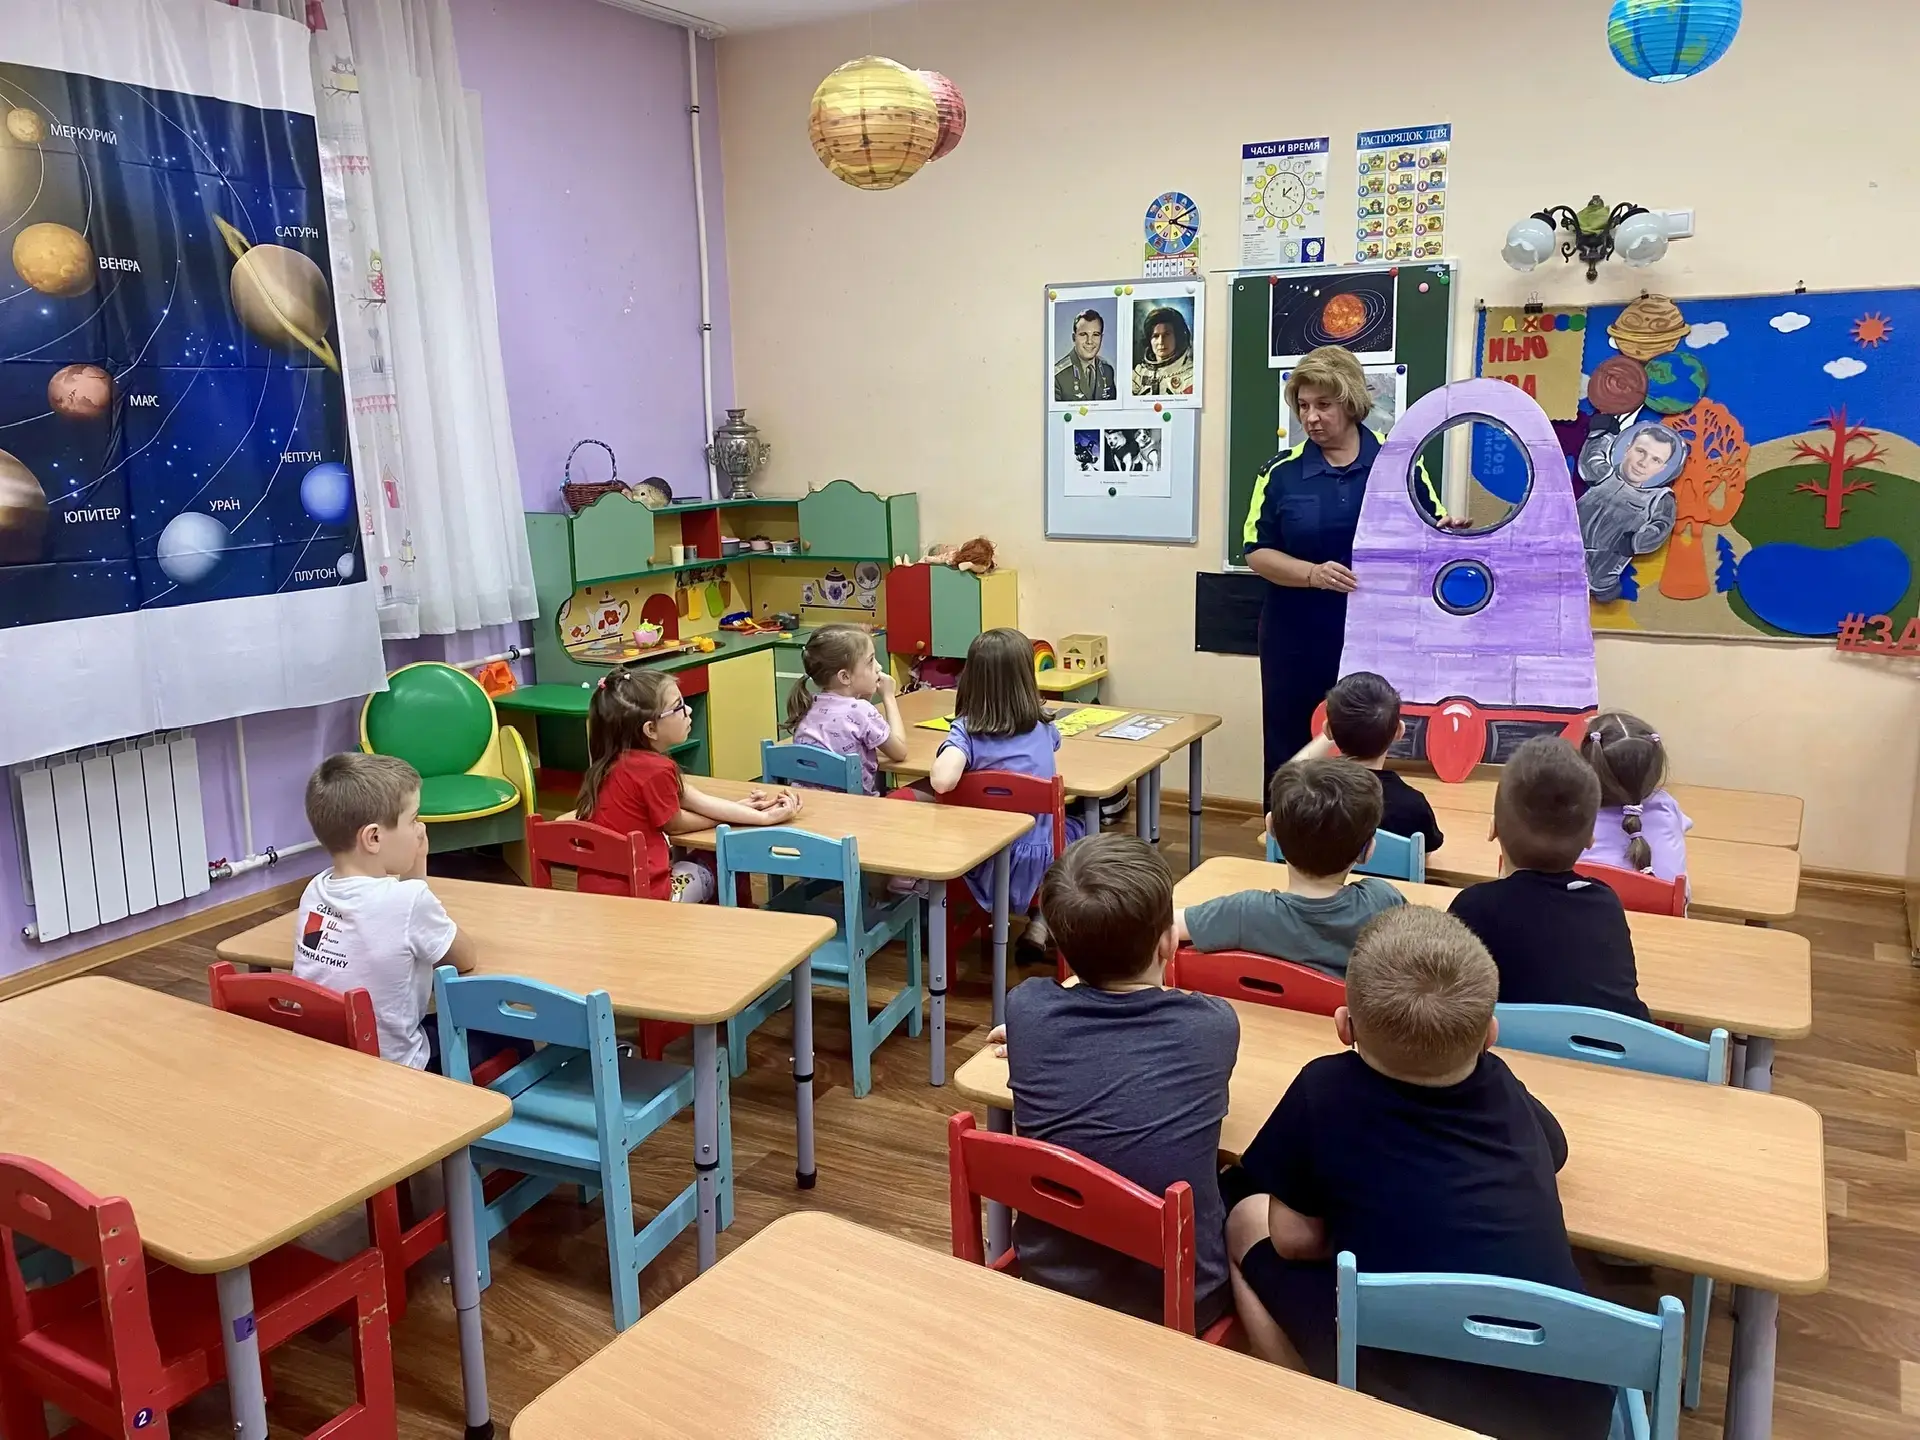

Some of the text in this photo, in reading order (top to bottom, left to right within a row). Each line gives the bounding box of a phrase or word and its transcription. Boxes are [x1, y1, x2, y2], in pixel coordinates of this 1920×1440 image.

[51, 123, 118, 145] МЕРКУРИЙ
[1360, 128, 1447, 146] РАСПОРЯДОК ДНЯ
[1250, 141, 1320, 155] ЧАСЫ И ВРЕМЯ
[275, 225, 319, 239] САТУРН
[99, 256, 141, 273] ВЕНЕРА
[130, 395, 160, 408] МАРС
[280, 451, 322, 463] НЕПТУН
[209, 499, 241, 511] УРАН
[64, 507, 121, 524] ЮПИТЕР
[294, 568, 337, 582] ПЛУТОН
[244, 1317, 253, 1333] 2
[138, 1410, 147, 1427] 2
